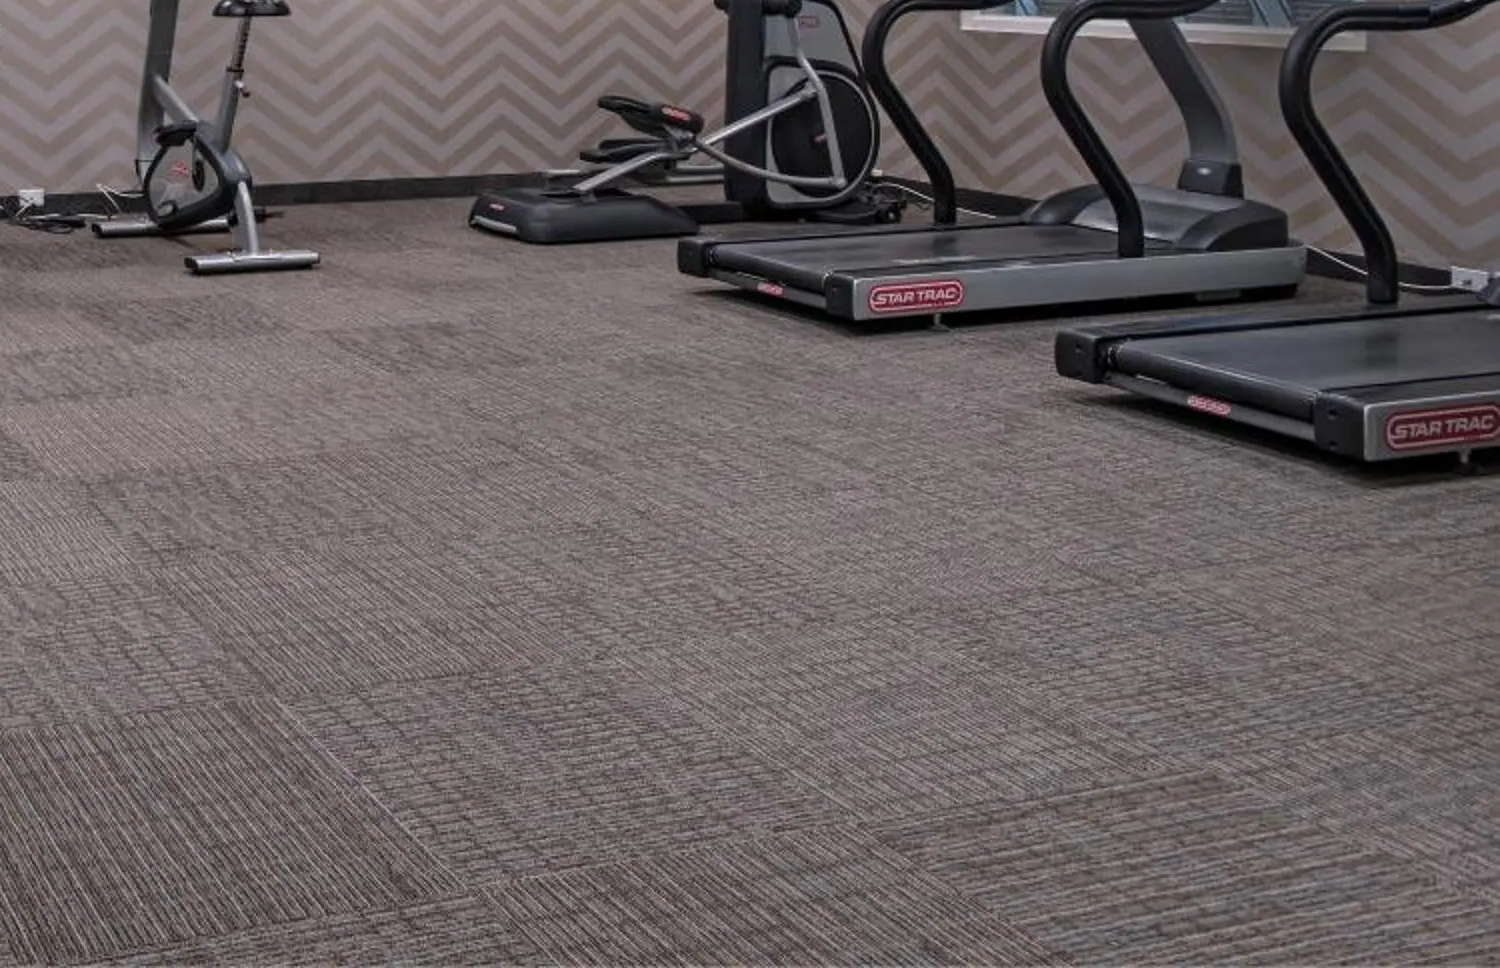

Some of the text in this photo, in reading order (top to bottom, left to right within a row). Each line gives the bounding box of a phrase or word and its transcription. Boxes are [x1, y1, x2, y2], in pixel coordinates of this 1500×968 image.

[876, 287, 959, 305] STAR TRAC
[1394, 414, 1495, 439] STAR TRAC
